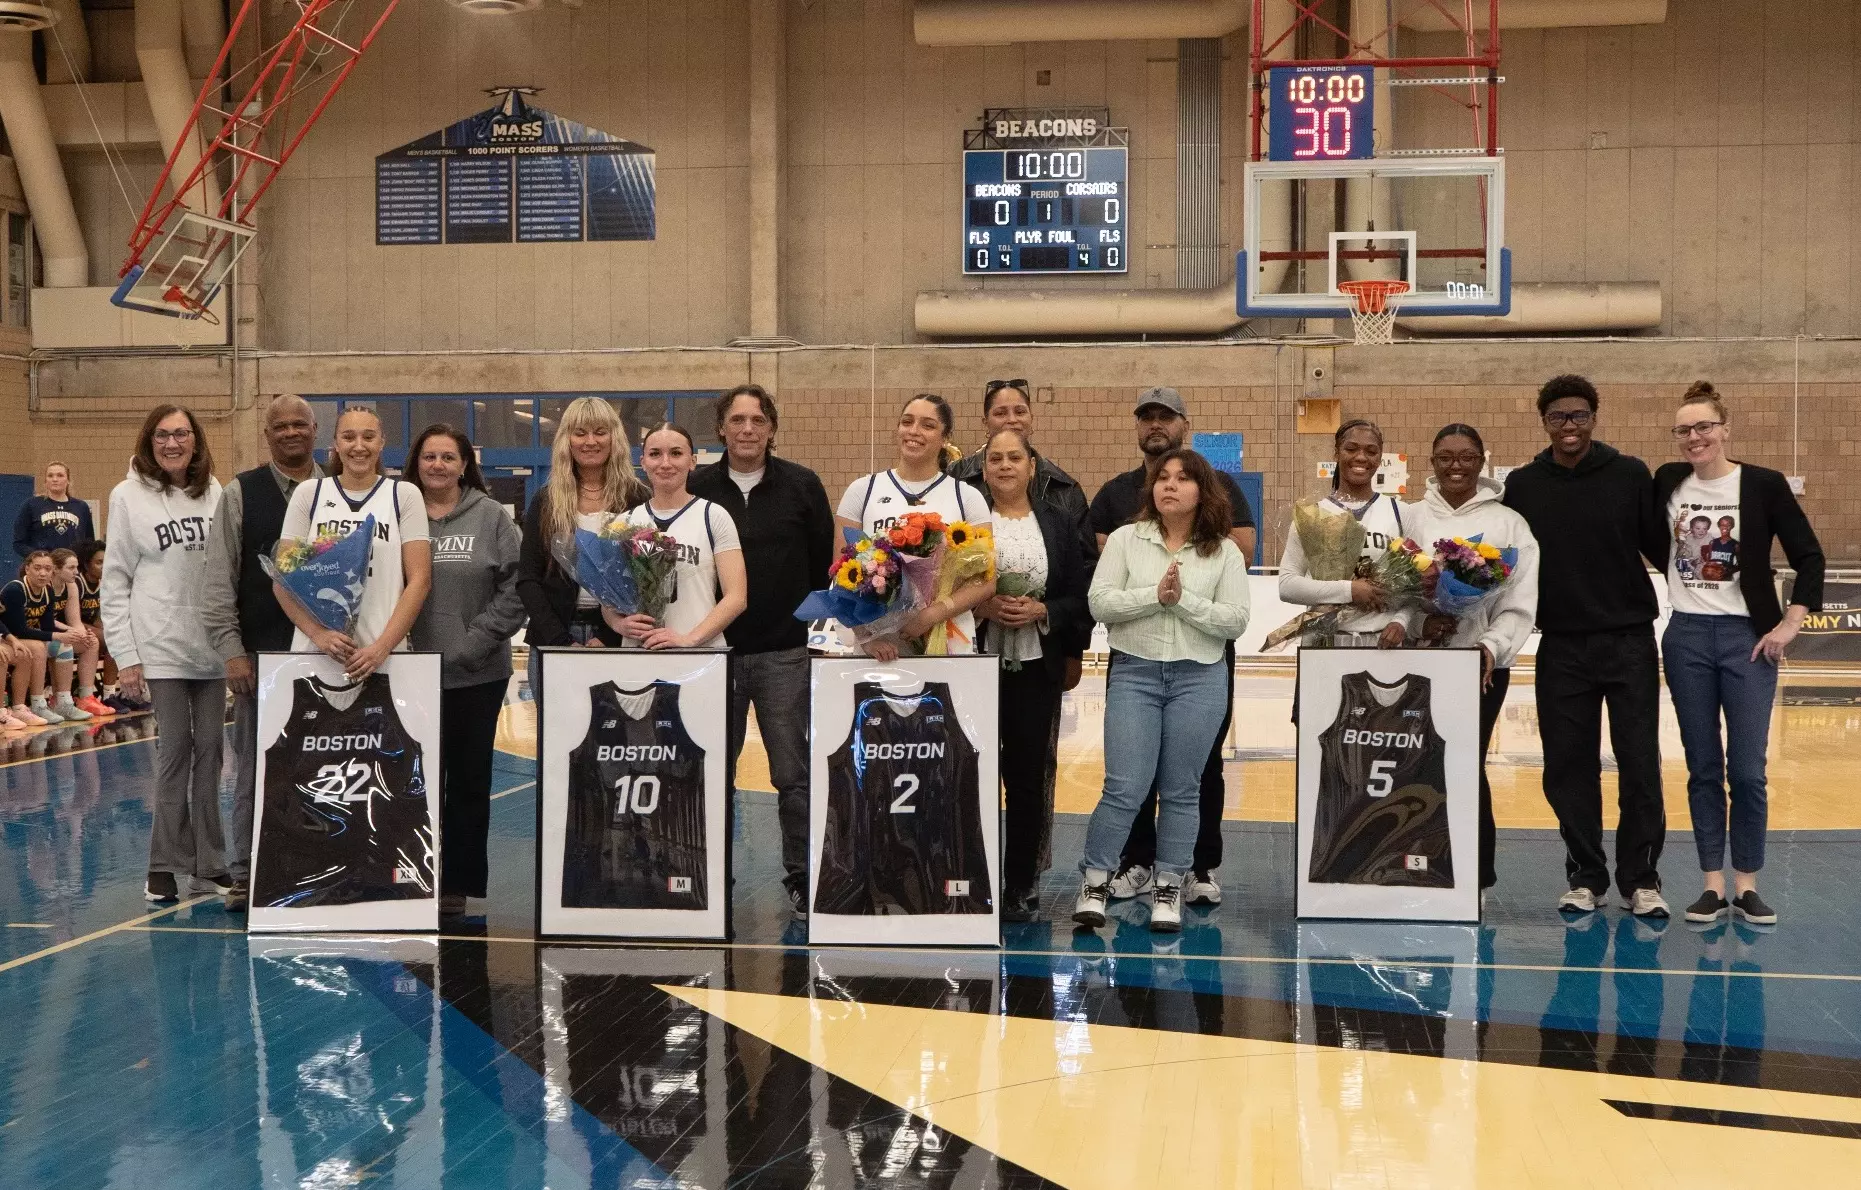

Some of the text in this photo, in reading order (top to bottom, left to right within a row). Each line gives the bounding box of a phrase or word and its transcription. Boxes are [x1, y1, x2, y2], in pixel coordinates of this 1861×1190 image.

[1289, 75, 1364, 103] 10:00
[492, 120, 543, 137] MASS
[996, 119, 1097, 138] BEACONS
[1295, 107, 1351, 156] 30
[468, 146, 559, 155] 1000 POINT SCORERS
[1018, 152, 1082, 178] 10:00
[975, 184, 1022, 197] BEACONS
[1030, 191, 1060, 199] PERIOD
[1066, 182, 1118, 196] CORSAIRS
[994, 200, 1010, 225] 0
[1046, 204, 1051, 221] 1
[1104, 198, 1120, 224] 0
[969, 231, 990, 244] FLS
[1015, 230, 1076, 244] PLYR FOUL
[1100, 230, 1121, 243] FLS
[977, 249, 989, 269] 0
[1001, 254, 1010, 266] 4
[1079, 253, 1089, 265] 4
[1107, 247, 1119, 267] 0
[1801, 615, 1842, 629] RMY
[302, 734, 382, 751] BOSTON
[1343, 729, 1424, 749] BOSTON
[597, 745, 676, 761] BOSTON
[864, 742, 945, 760] BOSTON
[314, 763, 372, 803] 22
[1366, 760, 1397, 798] 5
[614, 775, 661, 814] 10
[889, 773, 920, 814] 2
[1414, 857, 1420, 867] S
[676, 879, 686, 889] M
[955, 882, 962, 892] L
